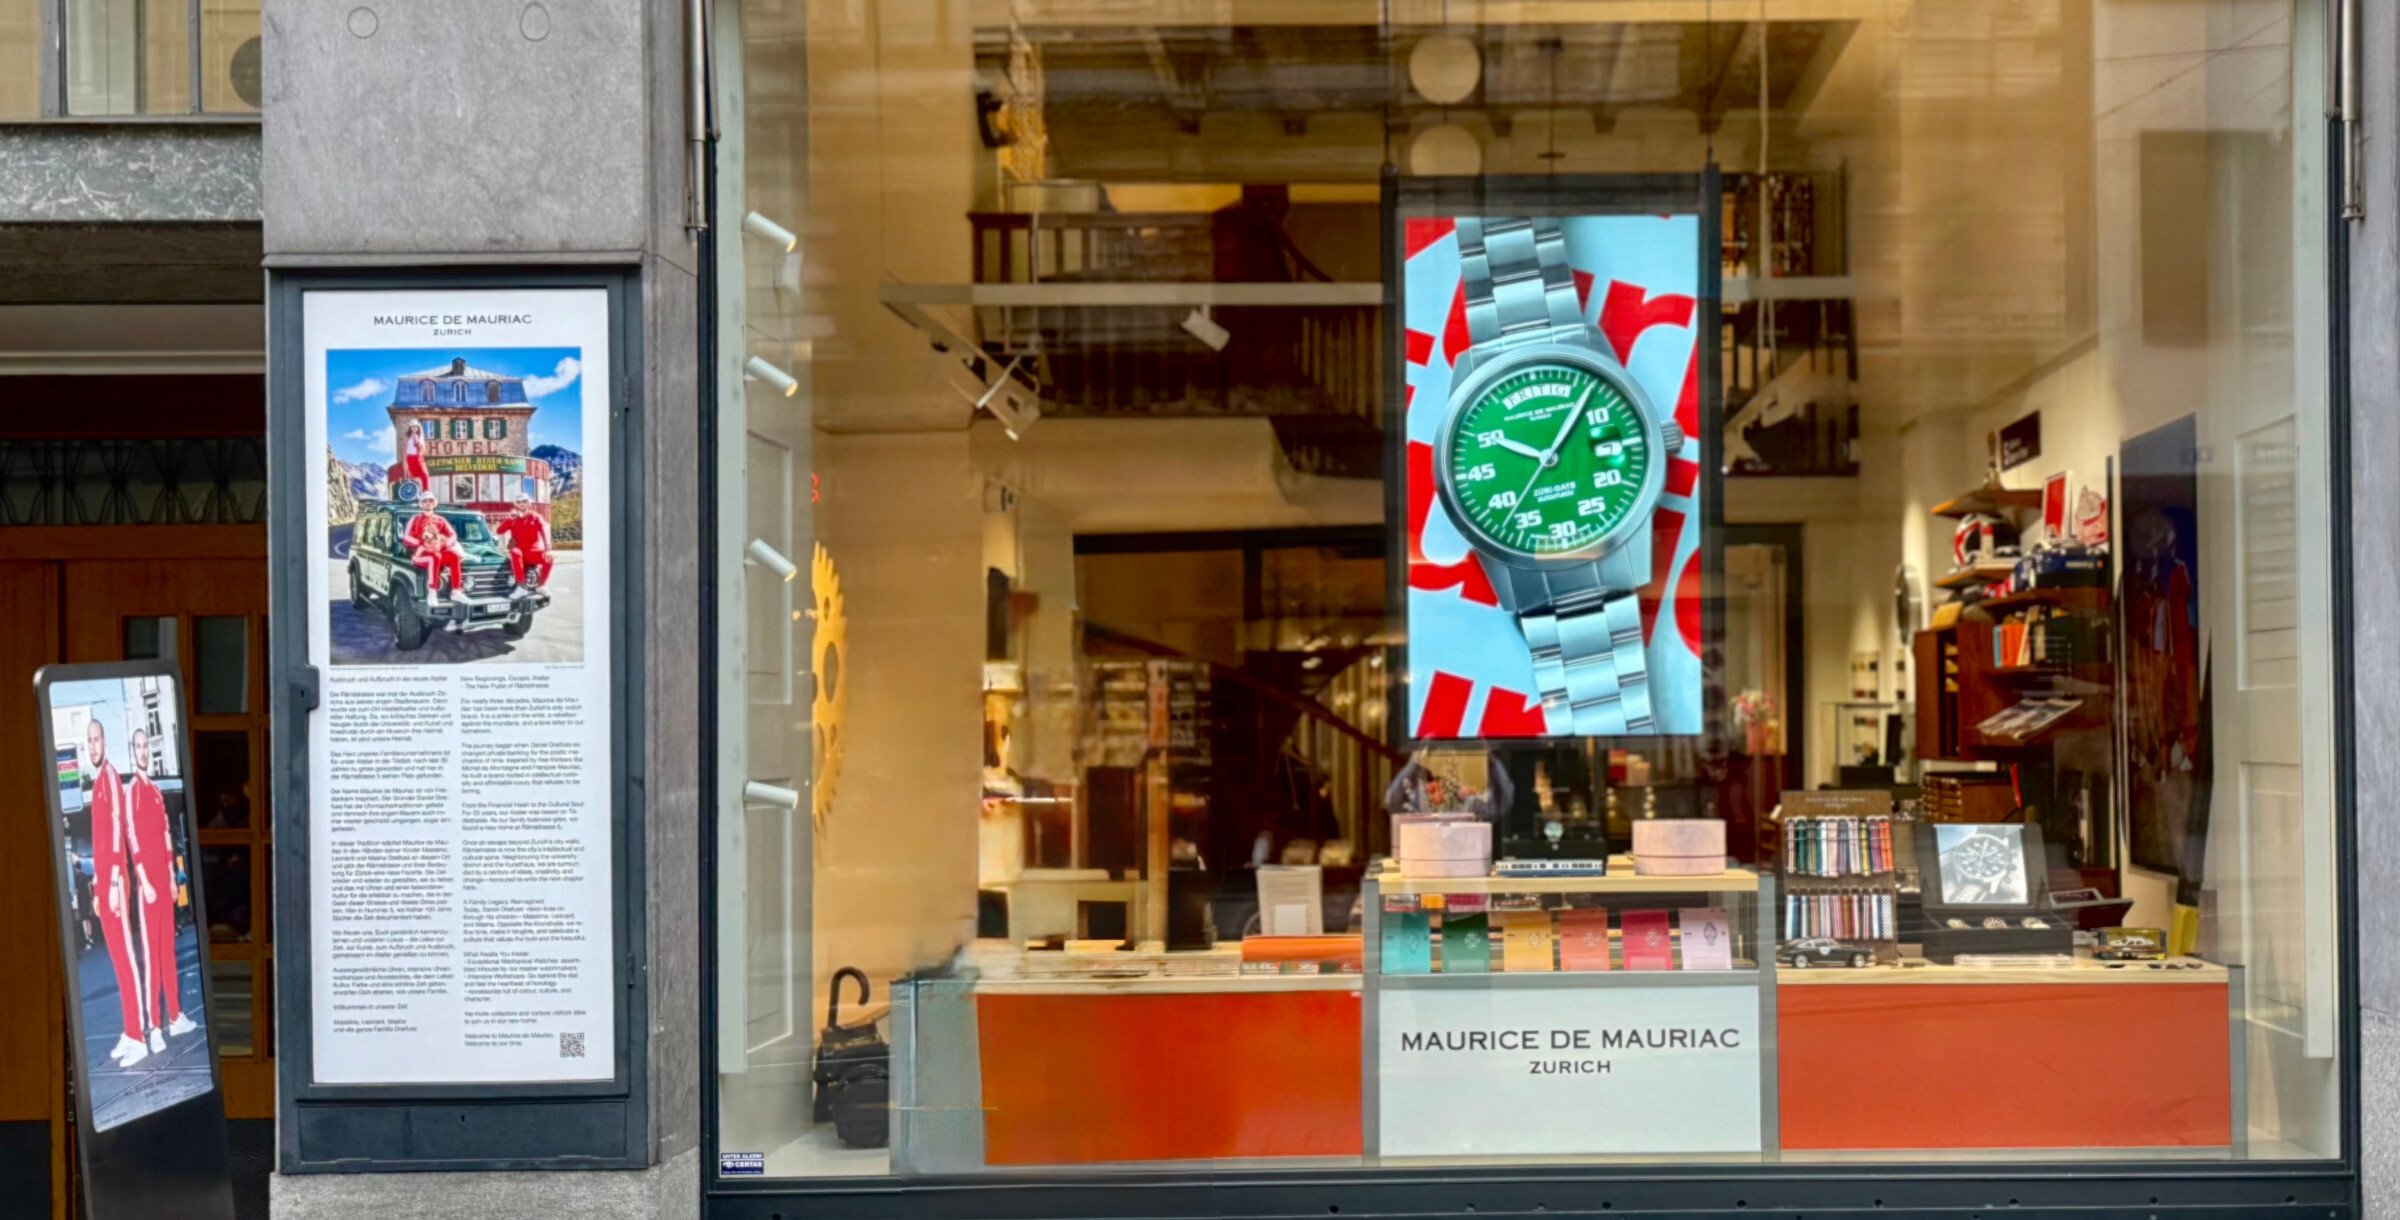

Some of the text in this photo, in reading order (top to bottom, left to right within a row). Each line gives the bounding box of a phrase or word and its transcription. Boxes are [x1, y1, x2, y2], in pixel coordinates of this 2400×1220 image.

[373, 314, 532, 325] MAURICE DE MAURIAC
[433, 328, 472, 336] ZURICH
[1586, 407, 1609, 426] 10
[428, 441, 498, 455] HOTEL
[1467, 463, 1496, 482] 45
[1592, 469, 1622, 489] 20
[1488, 490, 1517, 509] 40
[1577, 496, 1606, 517] 25
[1514, 509, 1543, 530] 35
[1548, 520, 1577, 539] 30
[1401, 1028, 1740, 1051] MAURICE DE MAURIAC
[1529, 1060, 1611, 1074] ZURICH
